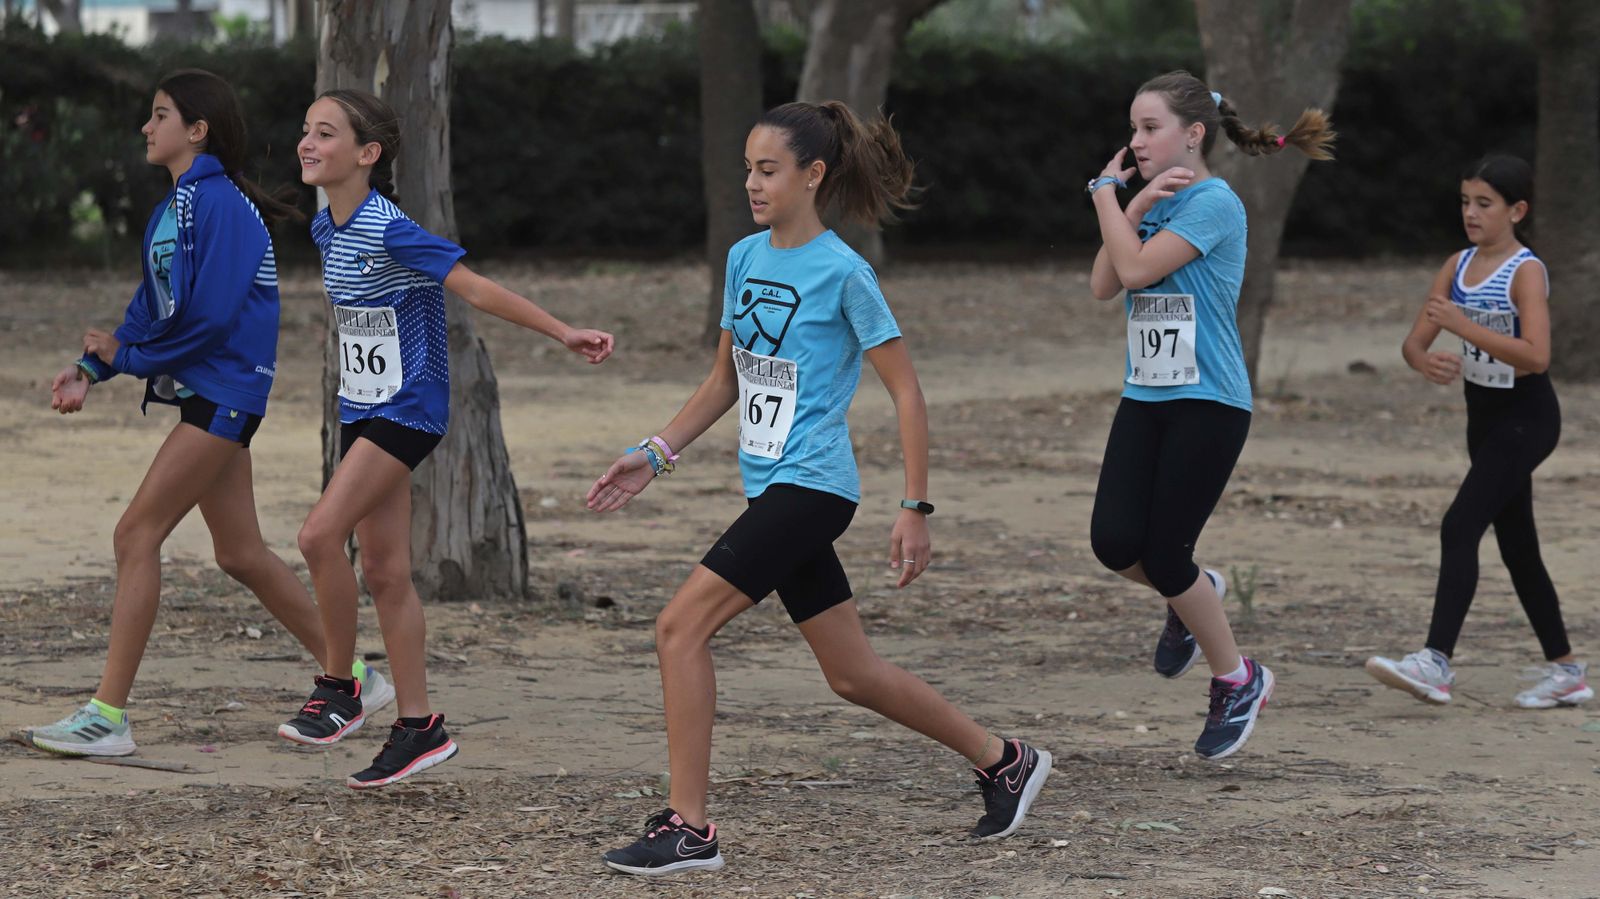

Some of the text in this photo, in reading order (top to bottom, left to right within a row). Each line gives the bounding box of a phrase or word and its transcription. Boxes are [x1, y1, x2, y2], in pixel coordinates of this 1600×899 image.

[761, 288, 782, 298] C.A.L.
[342, 341, 386, 376] 136
[1139, 328, 1180, 359] 197
[743, 387, 783, 429] 167
